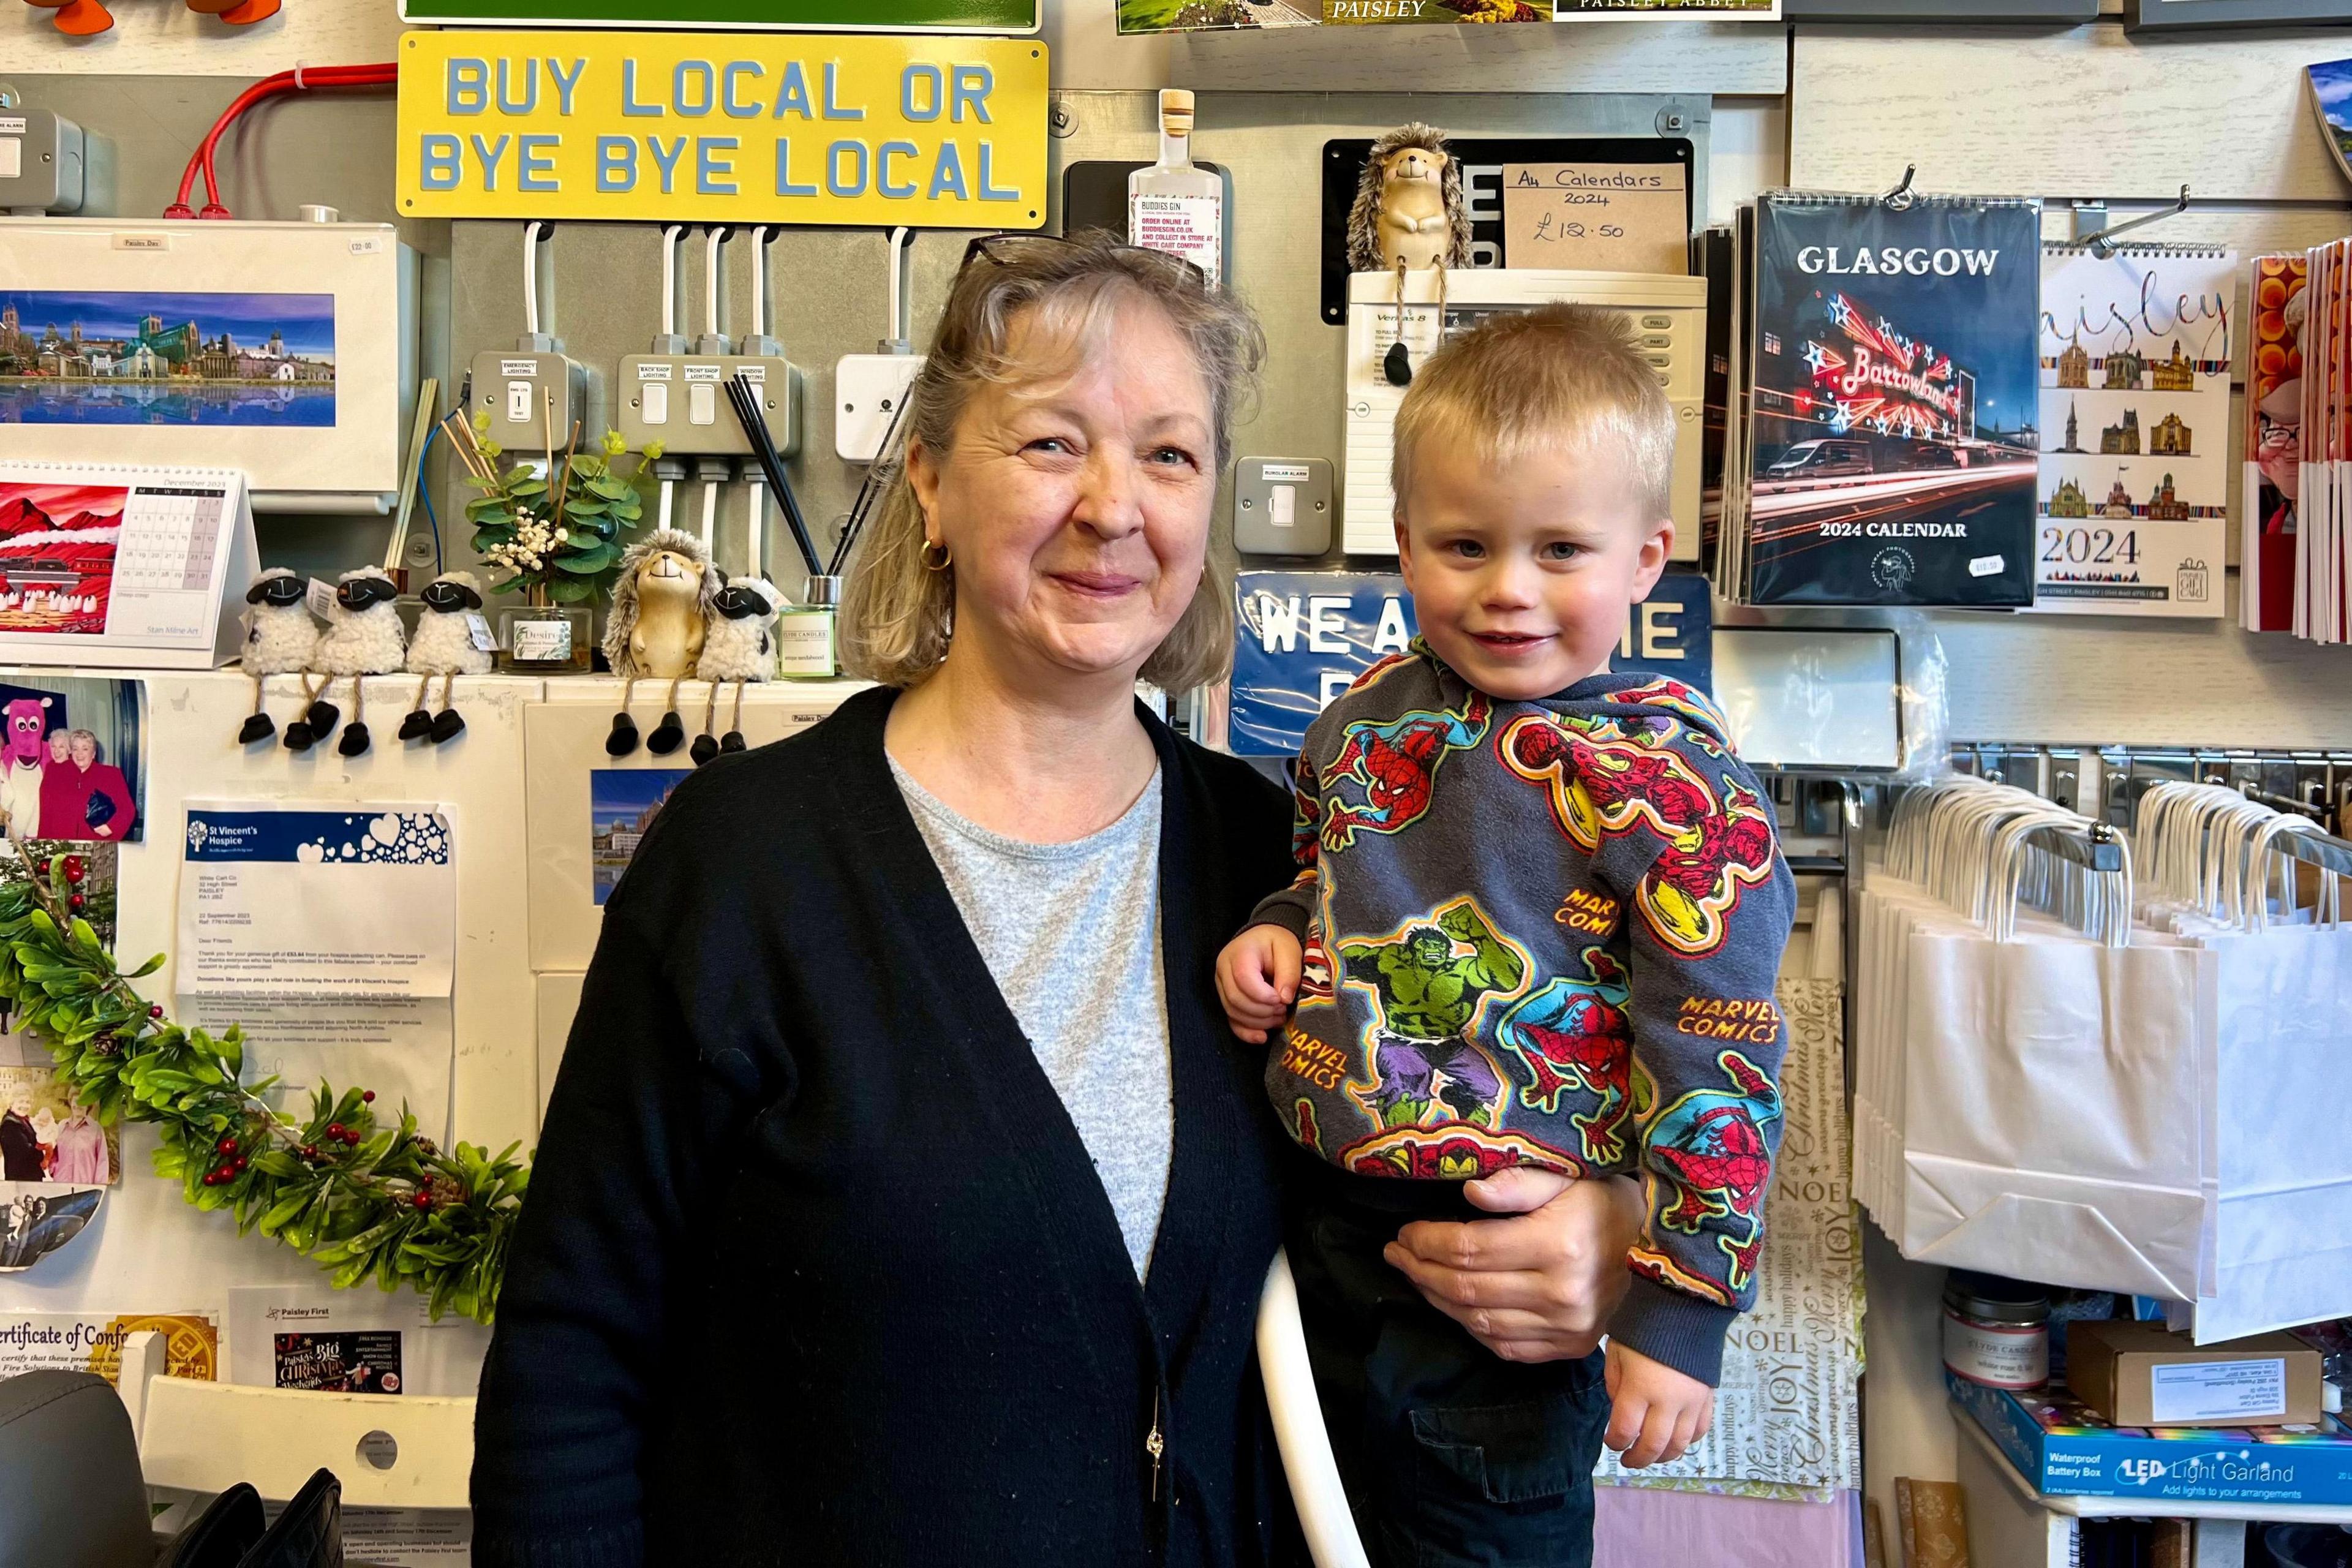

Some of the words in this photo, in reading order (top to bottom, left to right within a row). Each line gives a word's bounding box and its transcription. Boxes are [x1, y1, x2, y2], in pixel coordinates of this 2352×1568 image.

[1332, 0, 1426, 18] PAISLEY
[448, 56, 588, 116] BUY
[622, 58, 866, 121] LOCAL
[900, 63, 995, 124] OR
[421, 134, 562, 192] BYE
[596, 135, 740, 195] BYE
[776, 138, 1022, 202] LOCAL
[1518, 170, 1539, 187] A4
[1556, 168, 1662, 187] Calendars
[1564, 192, 1610, 206] 2024
[1796, 246, 2000, 276] GLASGOW
[1841, 344, 1950, 412] Barrowland
[1819, 522, 1862, 538] 2024
[1866, 522, 1968, 538] CALENDAR
[2042, 526, 2141, 564] 2024
[1259, 596, 1352, 654] WE
[209, 826, 217, 835] St
[219, 826, 258, 835] Vincent's
[209, 836, 243, 846] Hospice
[1680, 996, 1781, 1021] MARVEL
[1678, 1016, 1779, 1042] COMICS
[1289, 1029, 1348, 1073] ARVEL
[1281, 1049, 1341, 1090] OMICS
[1781, 1040, 1815, 1162] Christmas
[1778, 1244, 1796, 1291] holidays
[1779, 1293, 1796, 1329] happy
[1803, 1268, 1836, 1344] Merry
[66, 1322, 83, 1352] of
[314, 1341, 340, 1363] Big
[1, 1352, 28, 1363] certify
[70, 1355, 105, 1363] premises
[1768, 1355, 1803, 1417] JOY
[1722, 1393, 1739, 1441] holidays
[1790, 1341, 1826, 1468] Christmas
[1845, 1401, 1860, 1455] holidays
[2047, 1466, 2082, 1479] Battery
[2082, 1467, 2101, 1477] Box
[2049, 1452, 2101, 1464] Waterproof
[2124, 1459, 2164, 1477] LED
[2172, 1461, 2215, 1483] Light
[2222, 1462, 2294, 1482] Garland
[2162, 1485, 2180, 1494] Add
[2183, 1485, 2206, 1498] lights
[2219, 1488, 2239, 1499] your
[2241, 1488, 2302, 1499] arrangements
